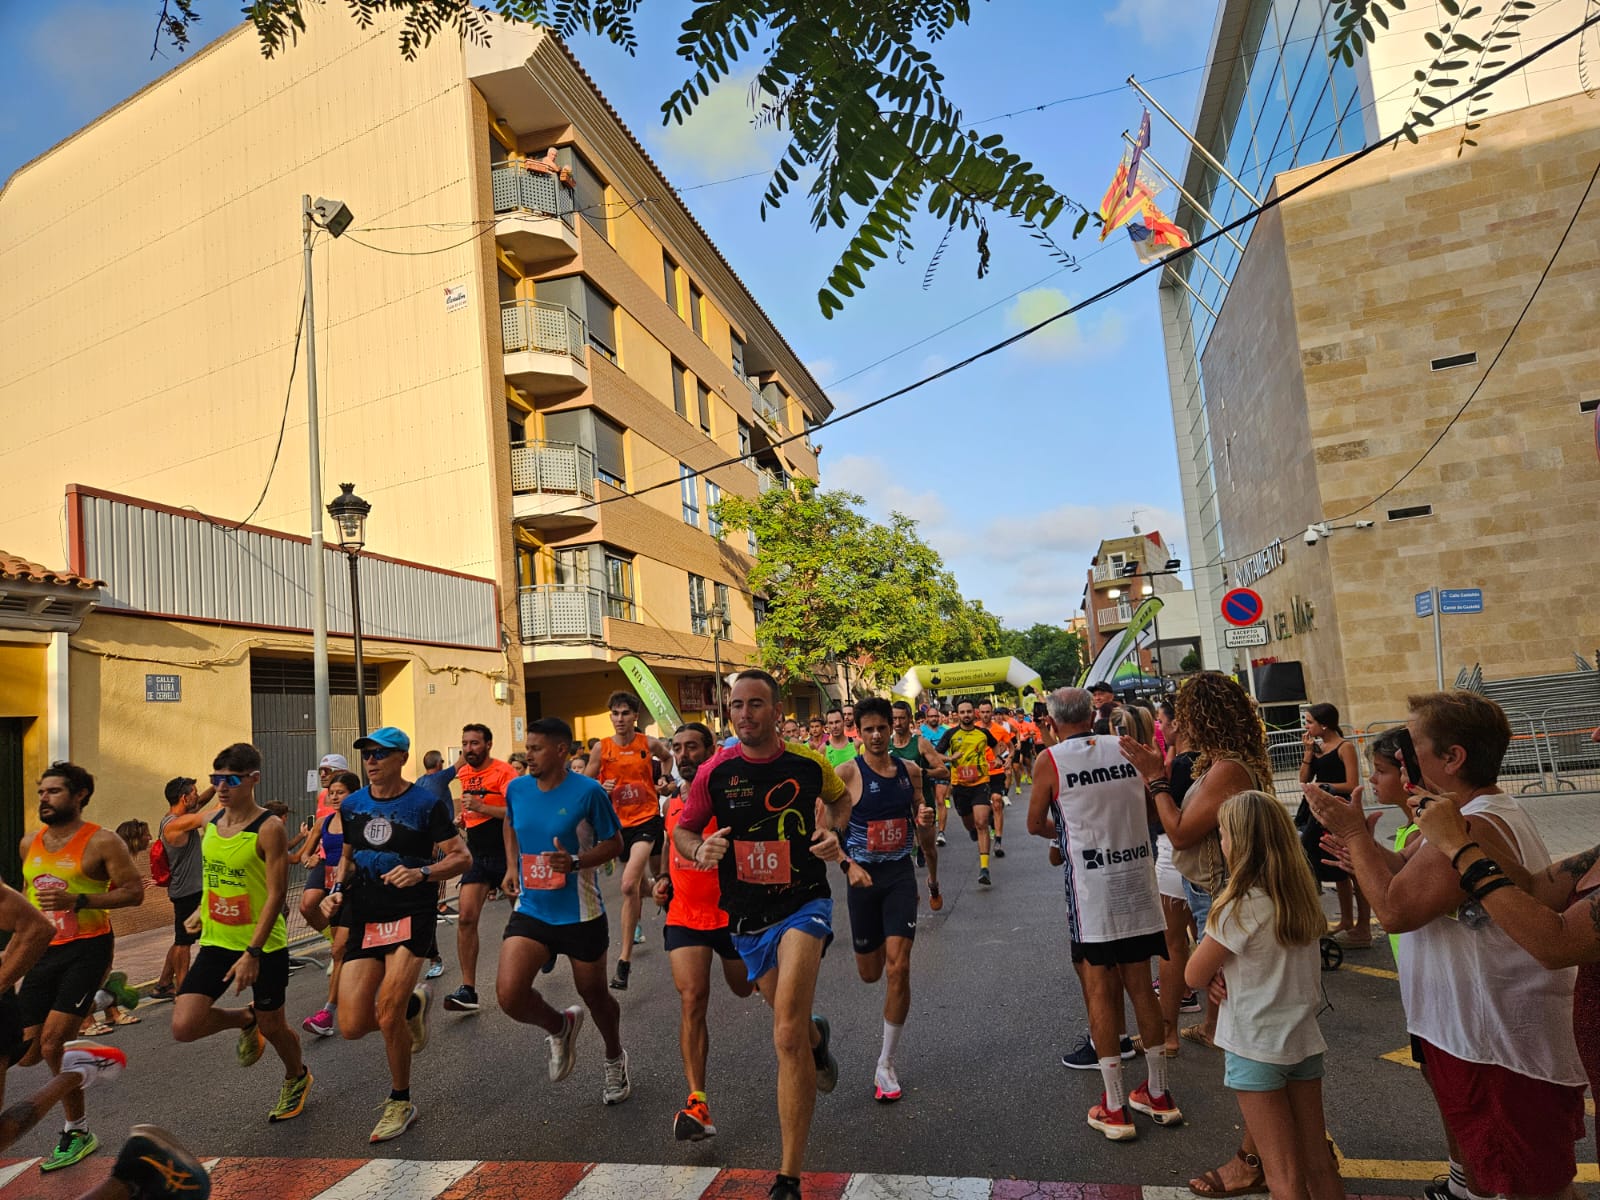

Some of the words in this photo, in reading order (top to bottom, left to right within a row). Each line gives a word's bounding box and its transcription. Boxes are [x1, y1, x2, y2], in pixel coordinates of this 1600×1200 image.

[156, 683, 175, 691] LAURA
[147, 691, 154, 700] DE
[1066, 763, 1138, 788] PAMESA
[620, 789, 639, 800] 291
[879, 829, 903, 843] 155
[1106, 841, 1150, 865] isaval
[747, 853, 779, 870] 116
[214, 902, 240, 917] 225
[377, 920, 400, 938] 107
